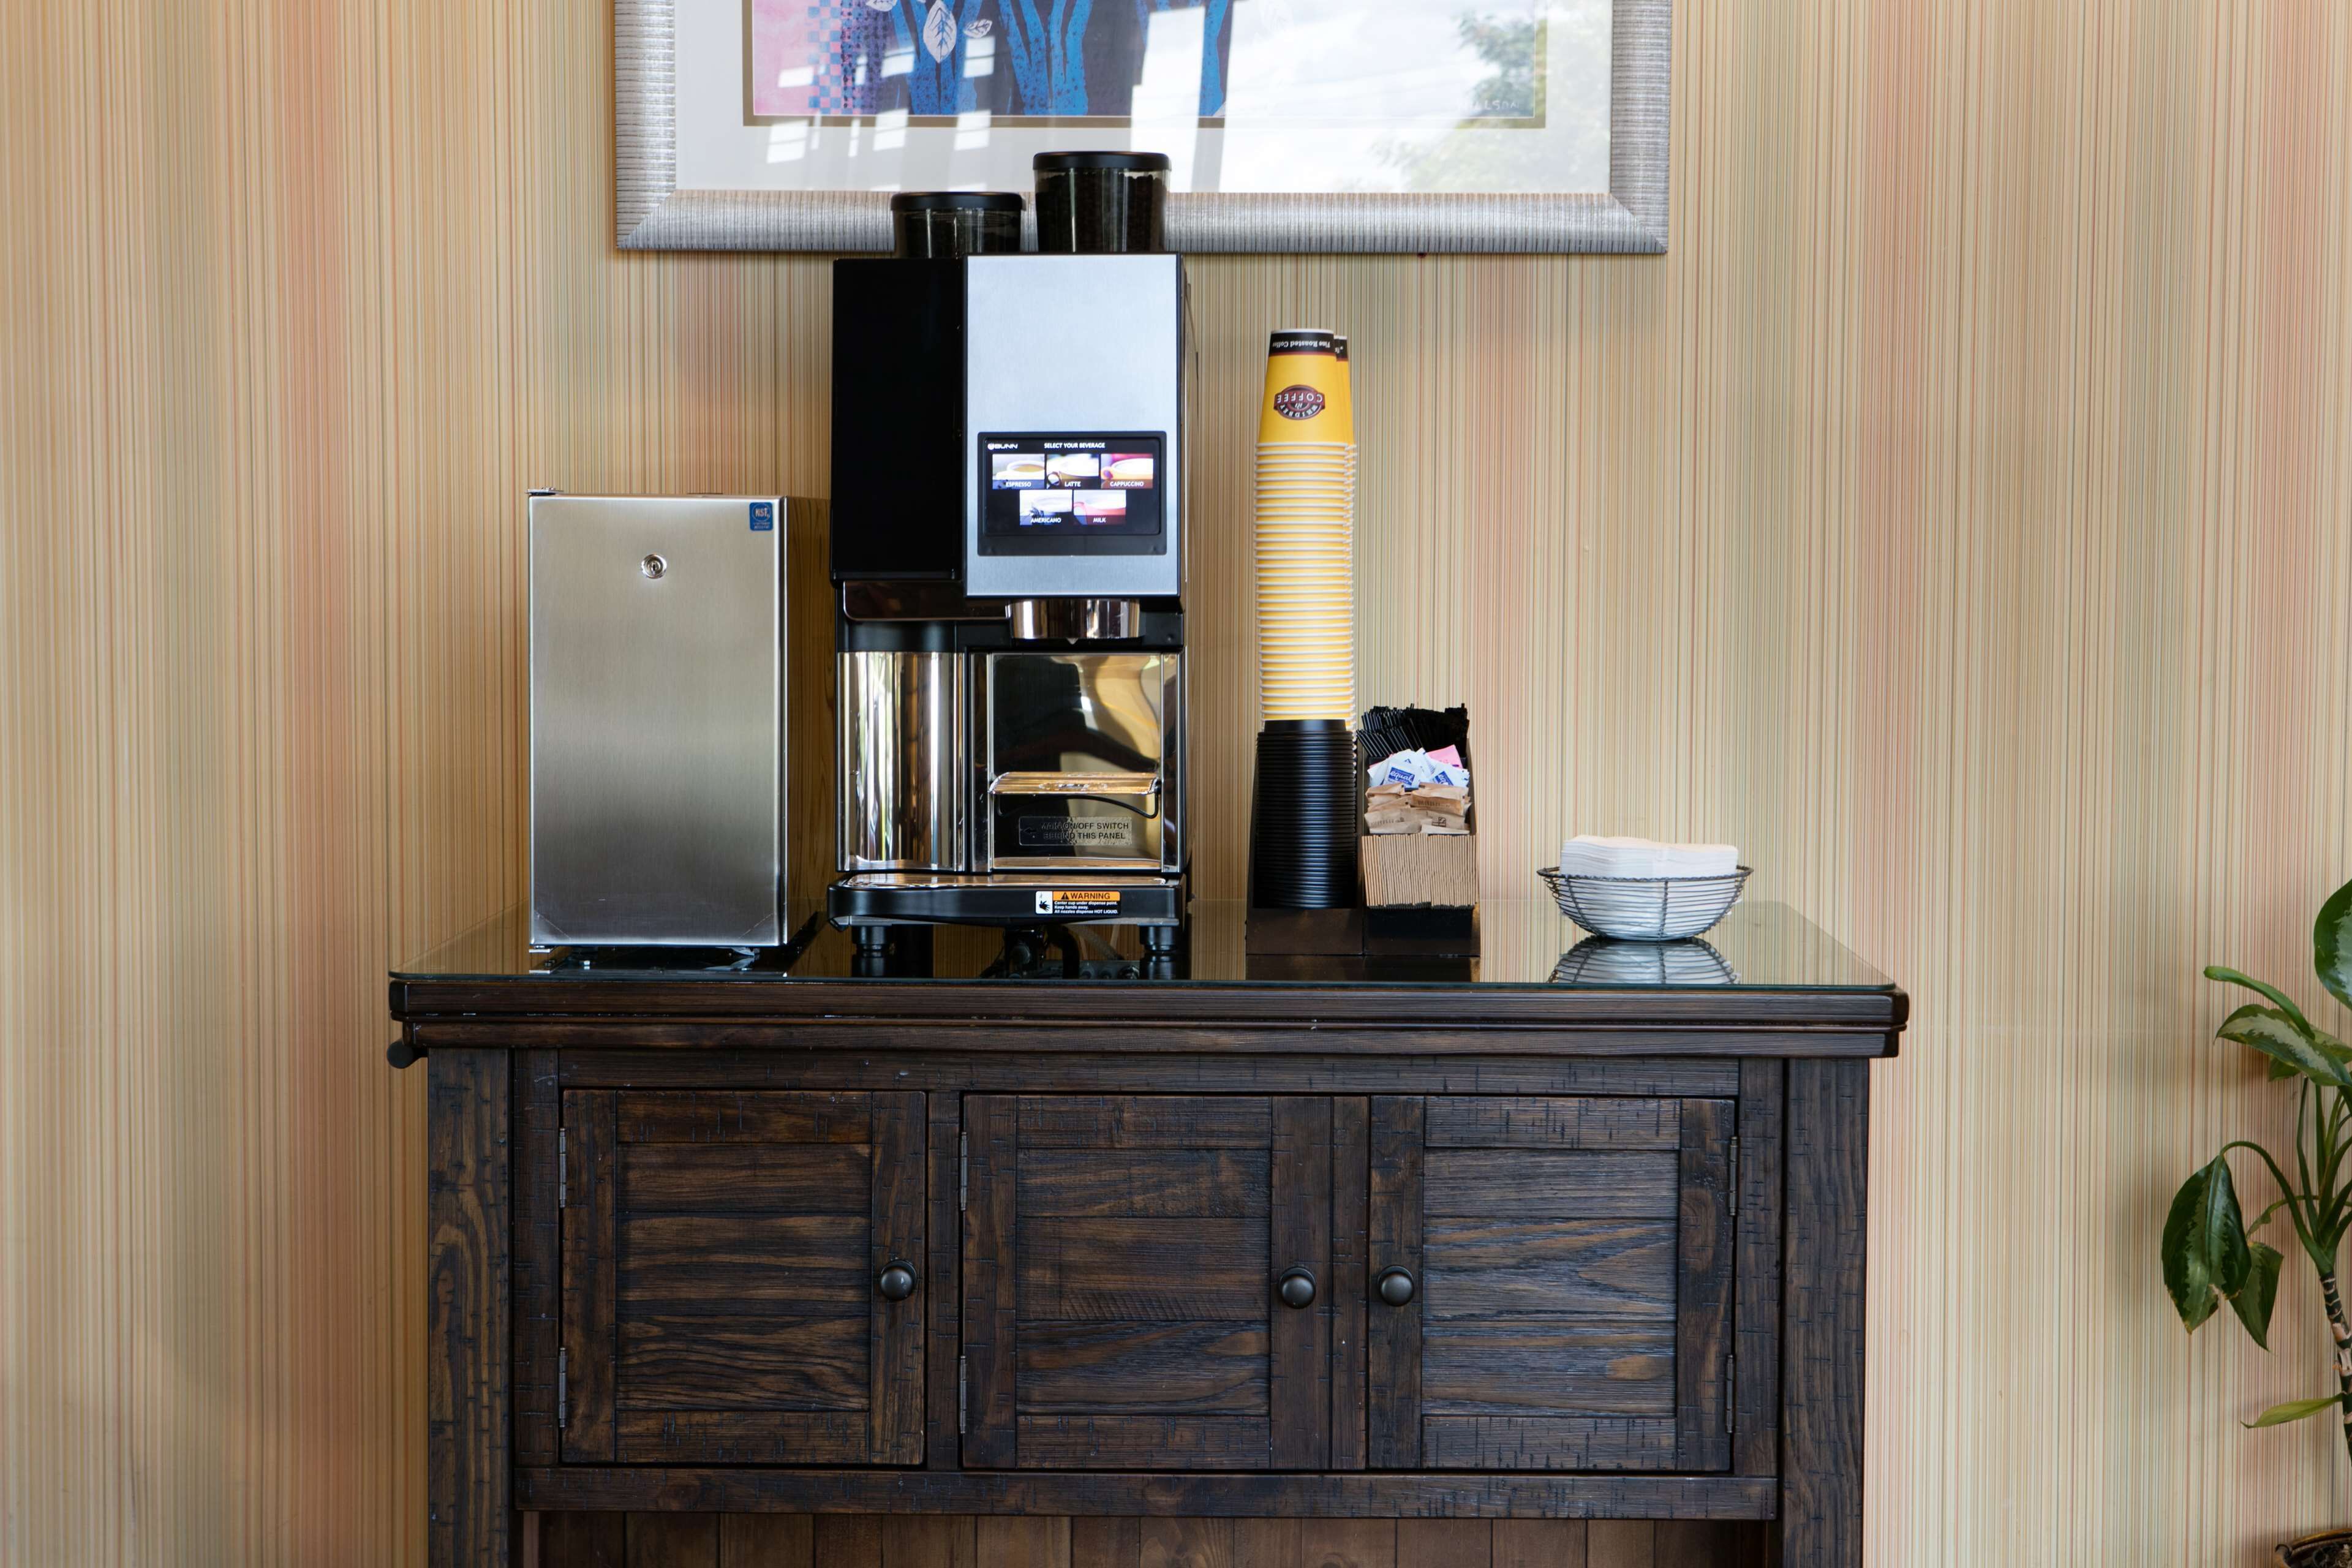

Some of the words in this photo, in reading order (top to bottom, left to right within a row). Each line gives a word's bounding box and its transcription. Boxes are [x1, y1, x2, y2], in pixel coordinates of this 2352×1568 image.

[1276, 393, 1323, 403] COFFEE
[1280, 404, 1318, 417] WHIDBEY
[755, 508, 769, 517] NSF
[1390, 770, 1413, 782] equal
